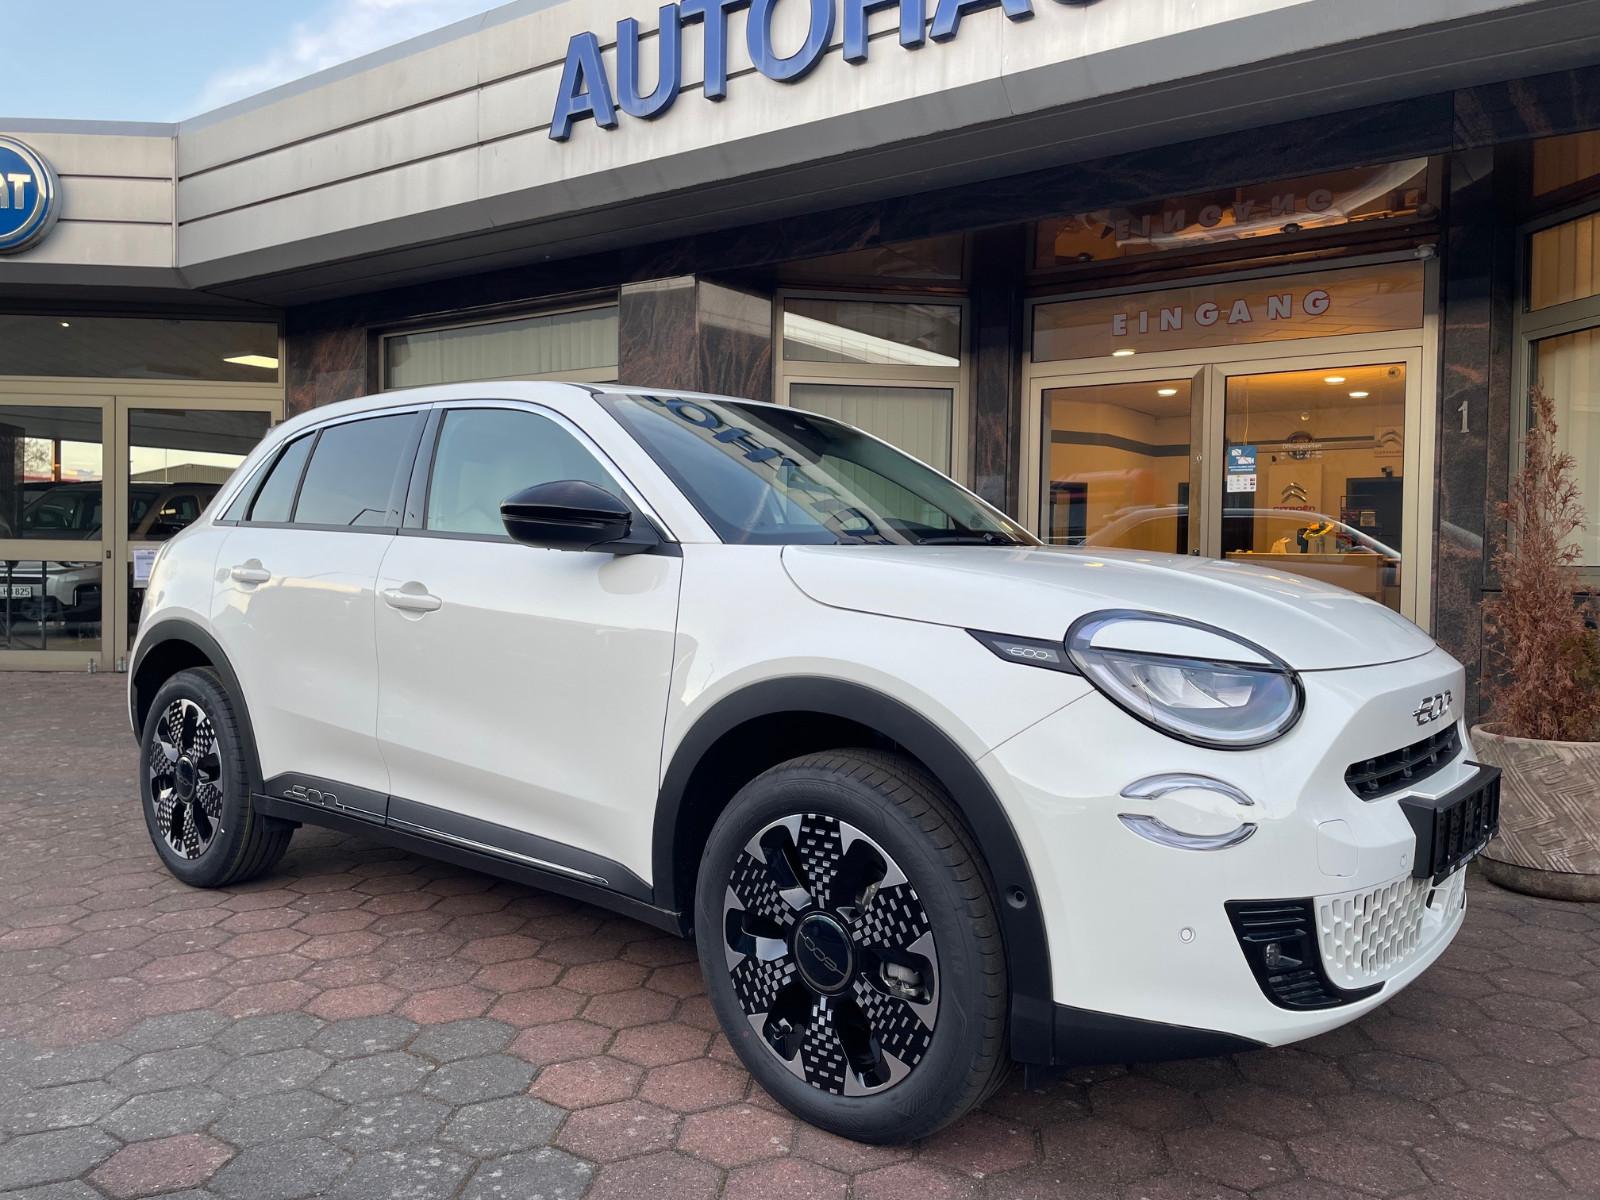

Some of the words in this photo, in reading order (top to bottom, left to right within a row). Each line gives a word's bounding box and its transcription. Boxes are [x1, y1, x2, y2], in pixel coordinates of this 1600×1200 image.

[1112, 289, 1330, 336] EINGANG
[1458, 400, 1470, 433] 1
[15, 587, 30, 596] 825
[1006, 647, 1053, 660] 600
